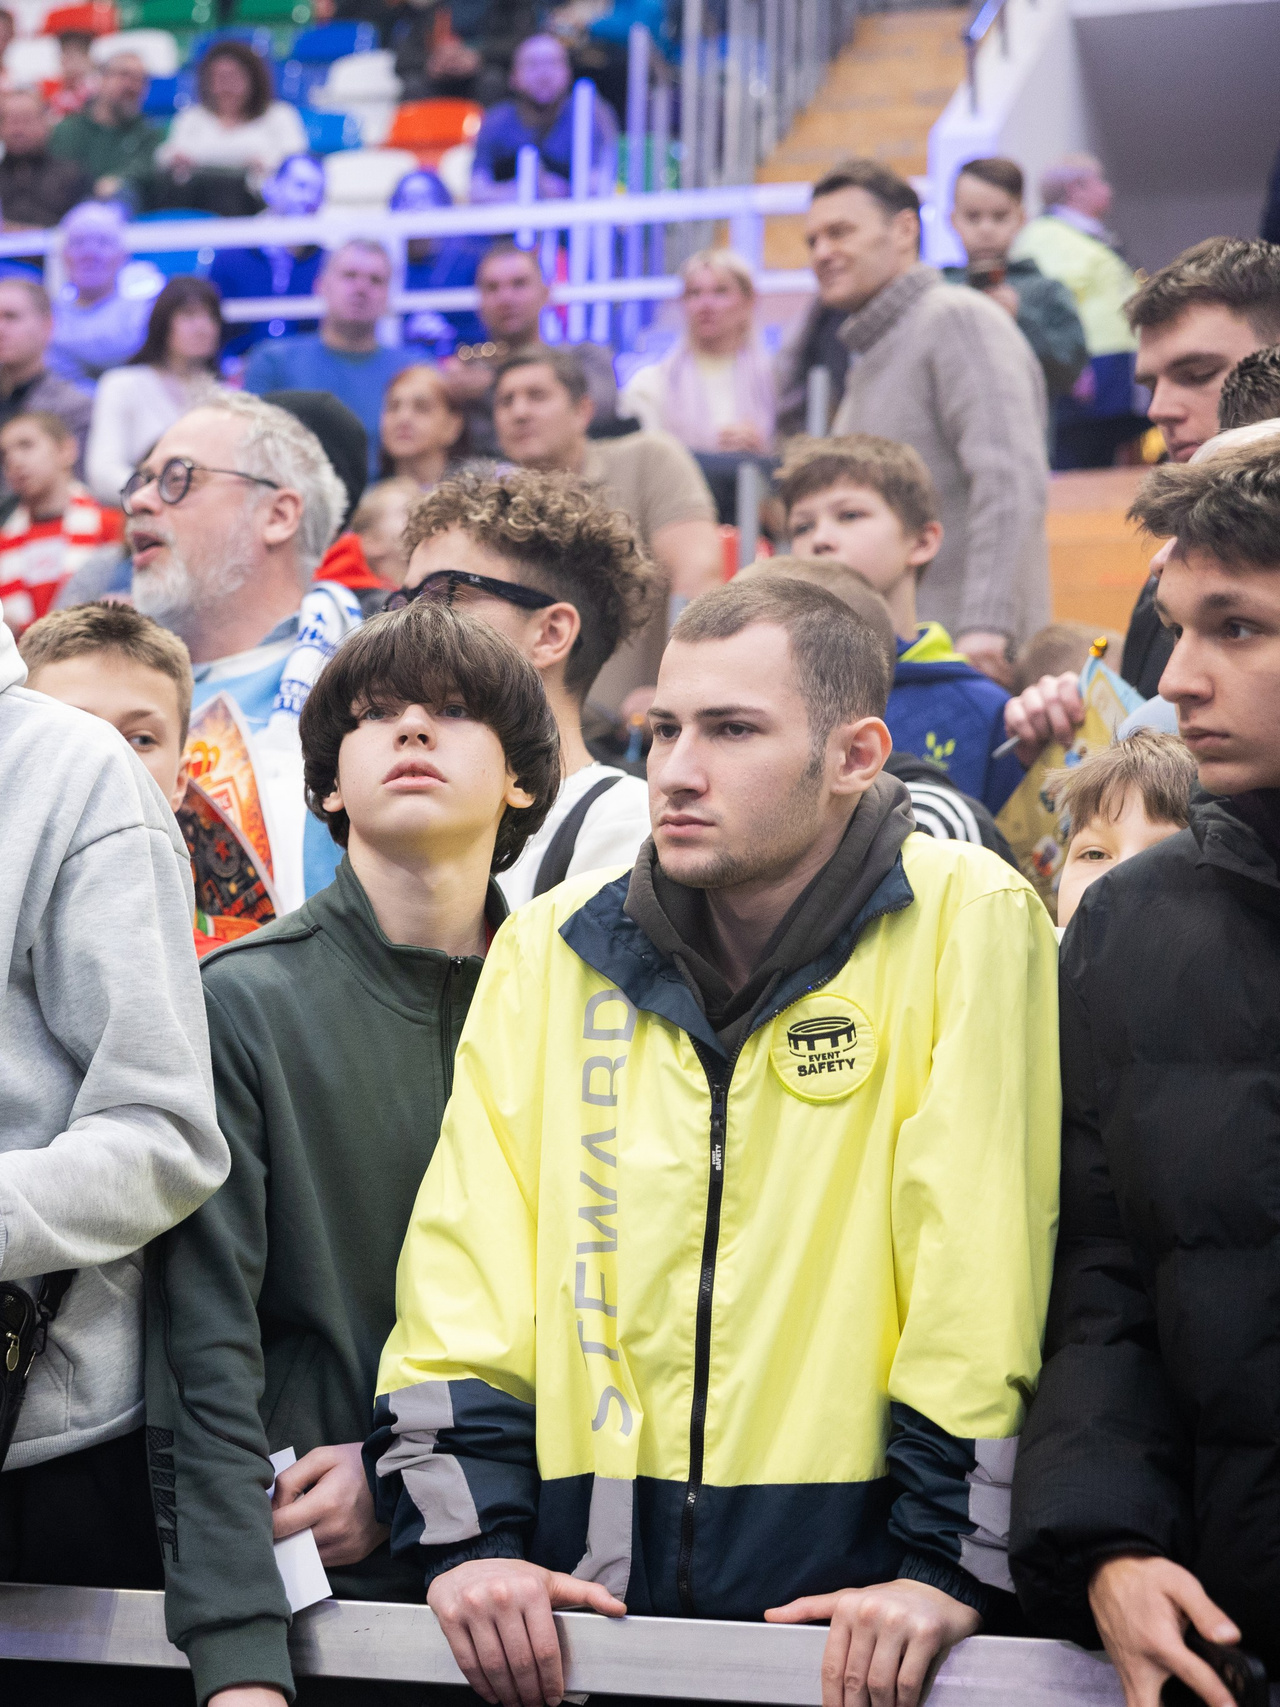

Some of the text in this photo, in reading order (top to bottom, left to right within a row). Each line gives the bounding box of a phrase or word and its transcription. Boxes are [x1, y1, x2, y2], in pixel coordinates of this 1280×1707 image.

[797, 1058, 856, 1077] SAFETY
[808, 1051, 841, 1063] EVENT
[574, 988, 638, 1438] STEWARD
[146, 1425, 179, 1563] NIKE
